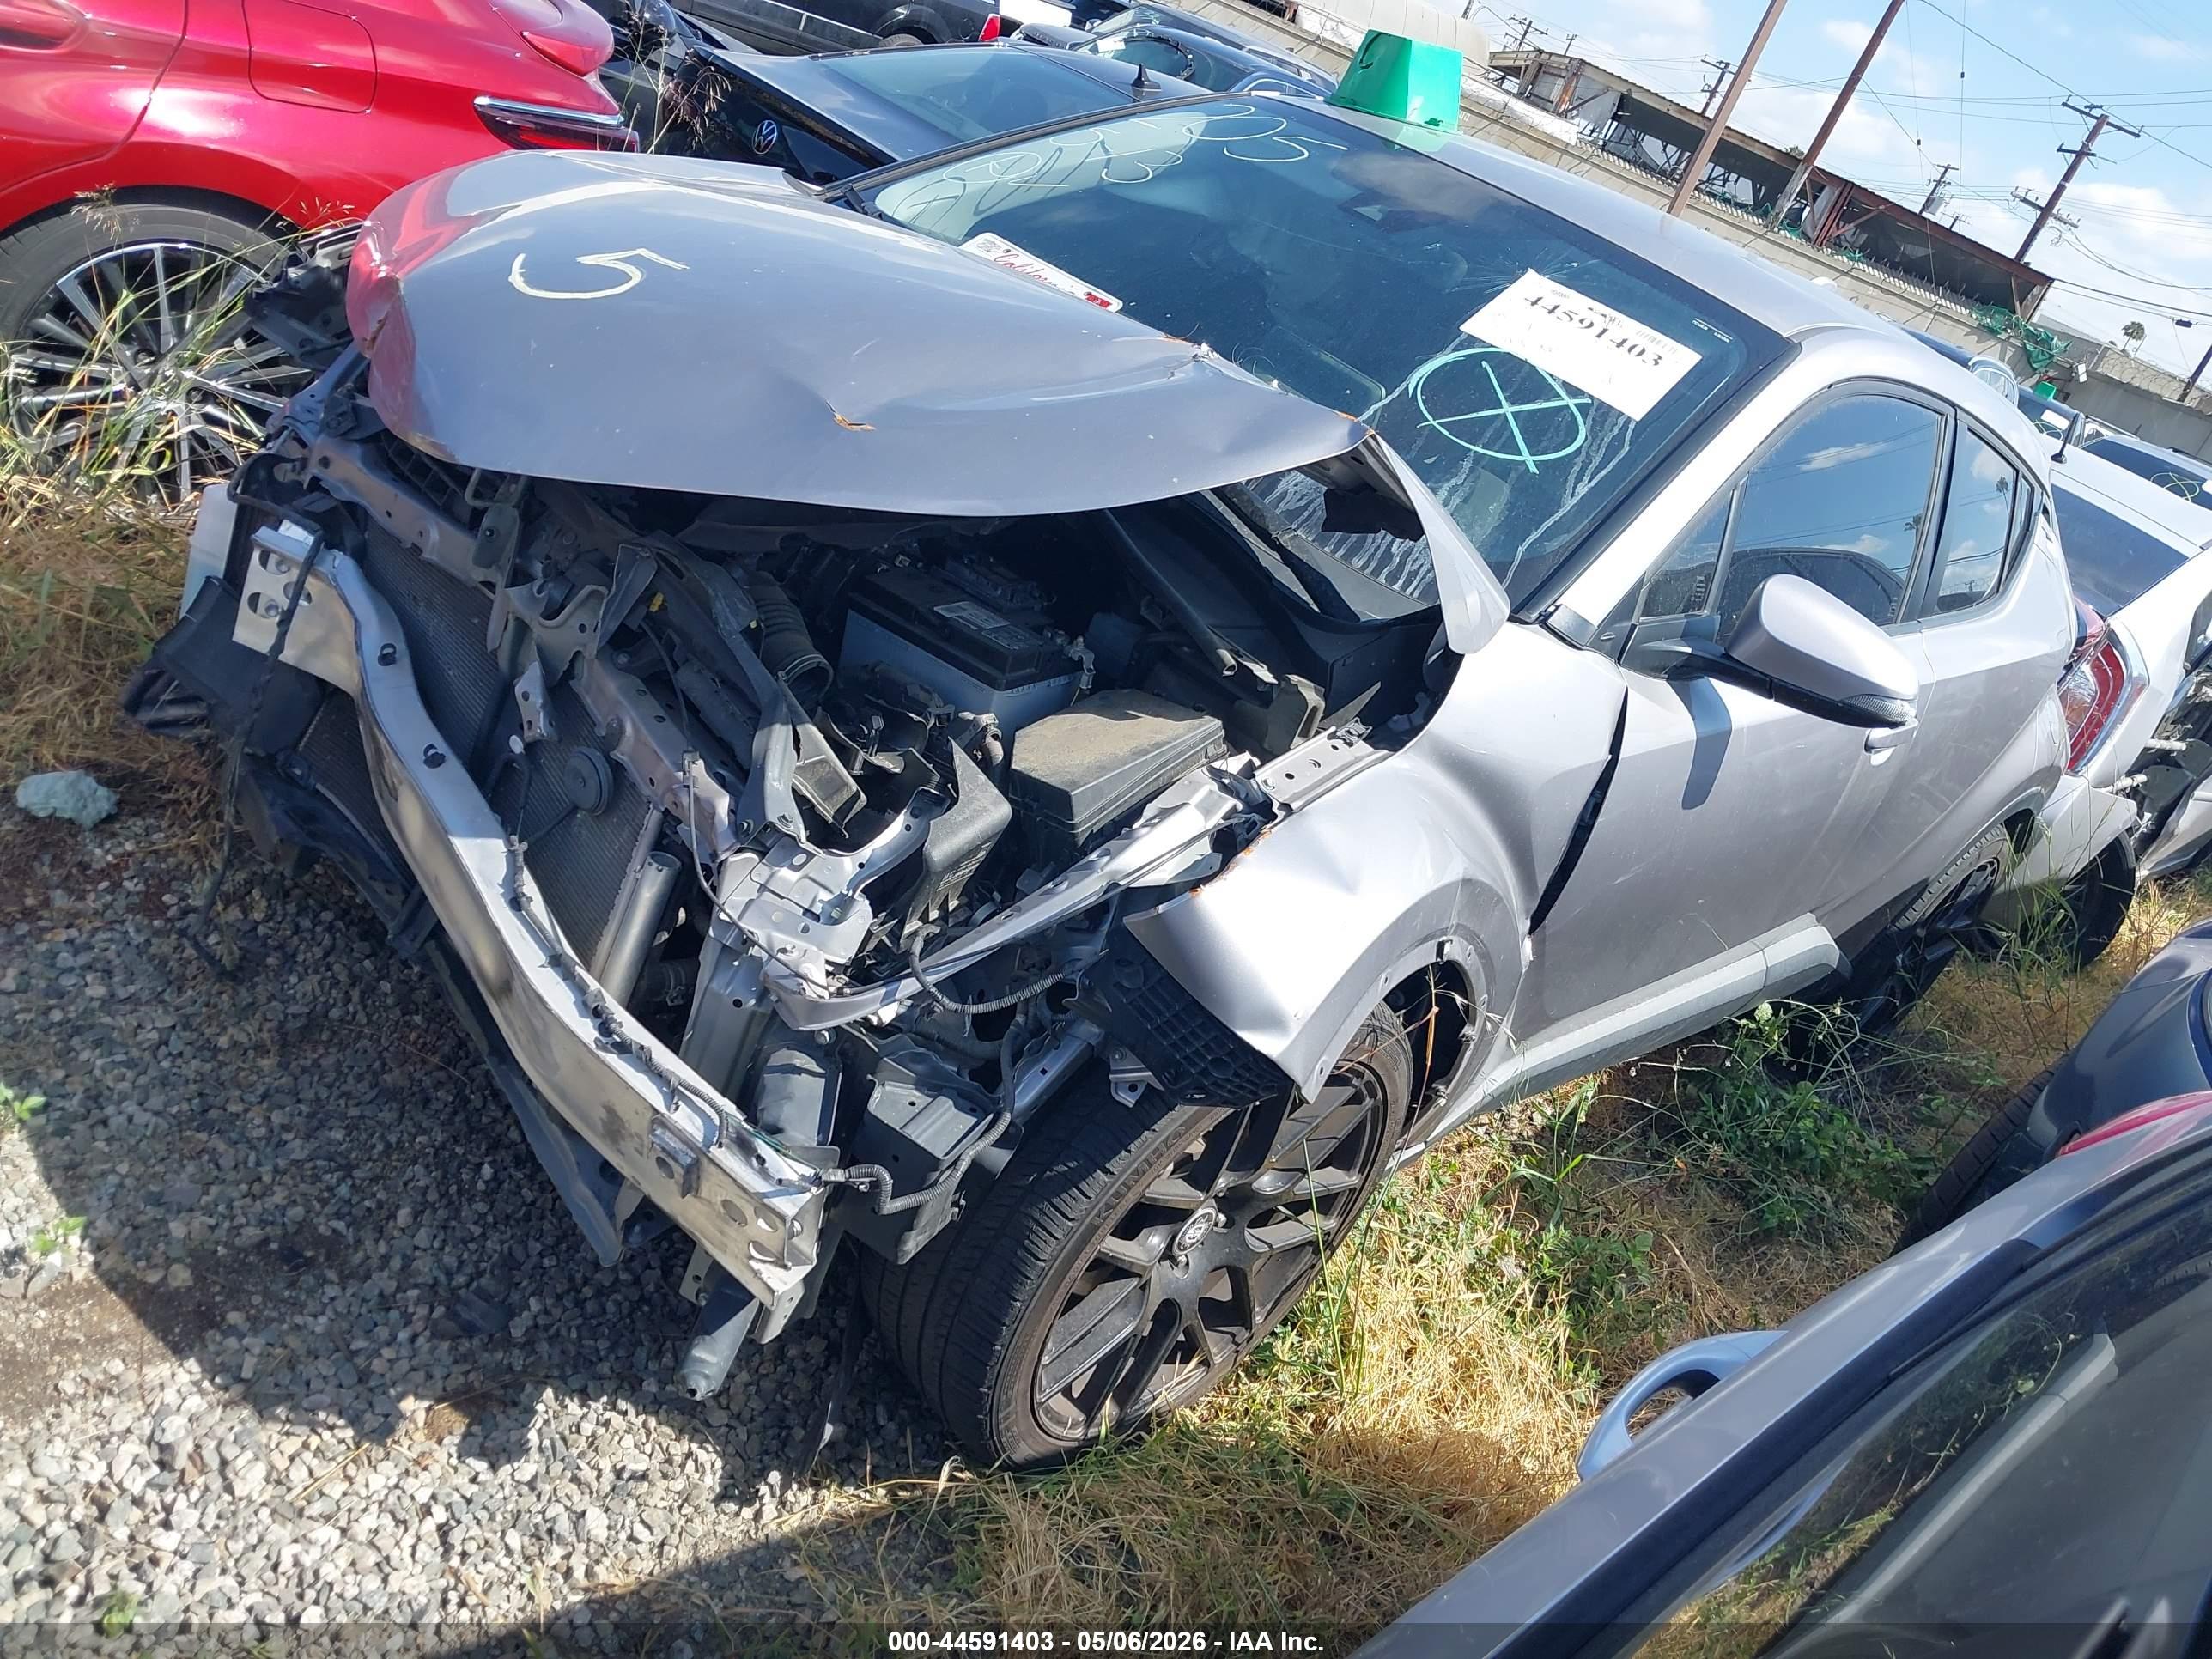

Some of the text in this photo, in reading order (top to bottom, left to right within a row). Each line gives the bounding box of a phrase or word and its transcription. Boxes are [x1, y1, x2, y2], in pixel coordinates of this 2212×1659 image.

[508, 248, 690, 299] 5
[994, 253, 1075, 295] Califor
[1524, 296, 1663, 367] 44591403
[1091, 1125, 1187, 1226] KUMHO
